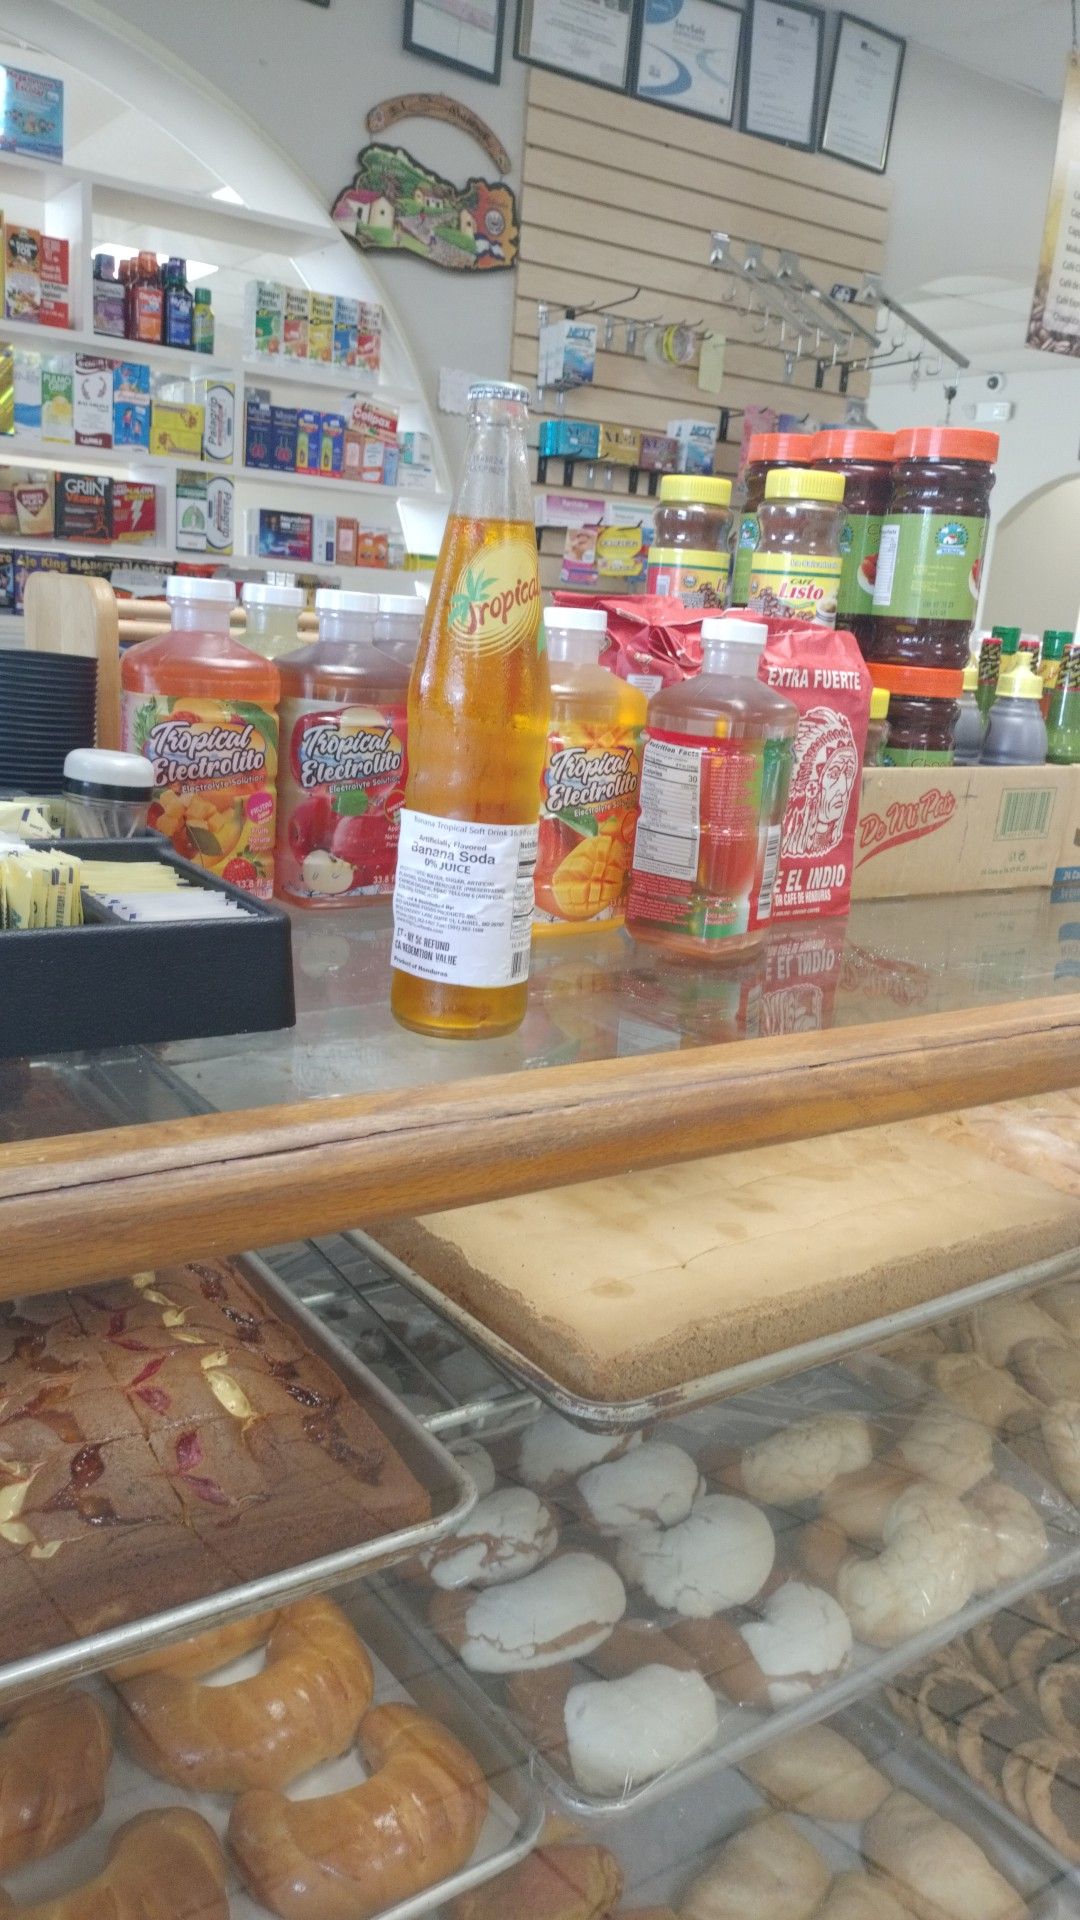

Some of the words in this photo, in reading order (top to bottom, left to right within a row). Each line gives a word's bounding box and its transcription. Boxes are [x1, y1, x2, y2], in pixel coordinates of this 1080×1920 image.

[777, 581, 824, 601] Listo
[767, 666, 810, 689] EXTRA
[813, 669, 862, 691] FUERTE
[150, 720, 256, 761] Tropical
[302, 723, 394, 762] Tropical
[151, 748, 266, 788] Electrolito
[301, 751, 402, 789] Electrolito
[551, 747, 634, 786] Tropical
[687, 774, 698, 785] 30
[546, 771, 639, 814] Electrolito
[438, 821, 468, 833] Tropical
[469, 826, 486, 836] Soft
[487, 828, 508, 837] Drink
[412, 841, 455, 861] Banana
[459, 850, 496, 866] Soda
[419, 834, 452, 849] Artificially
[453, 841, 488, 852] Flavored
[373, 873, 391, 884] 33.8
[424, 857, 438, 869] 0%
[439, 861, 472, 875] JUICE
[785, 868, 803, 893] EL
[806, 864, 846, 890] INDIO
[797, 891, 805, 904] DE
[394, 939, 402, 950] CA
[435, 952, 458, 966] VALUE
[423, 937, 450, 952] REFUND
[393, 954, 412, 967] Product
[418, 965, 449, 978] Honduras
